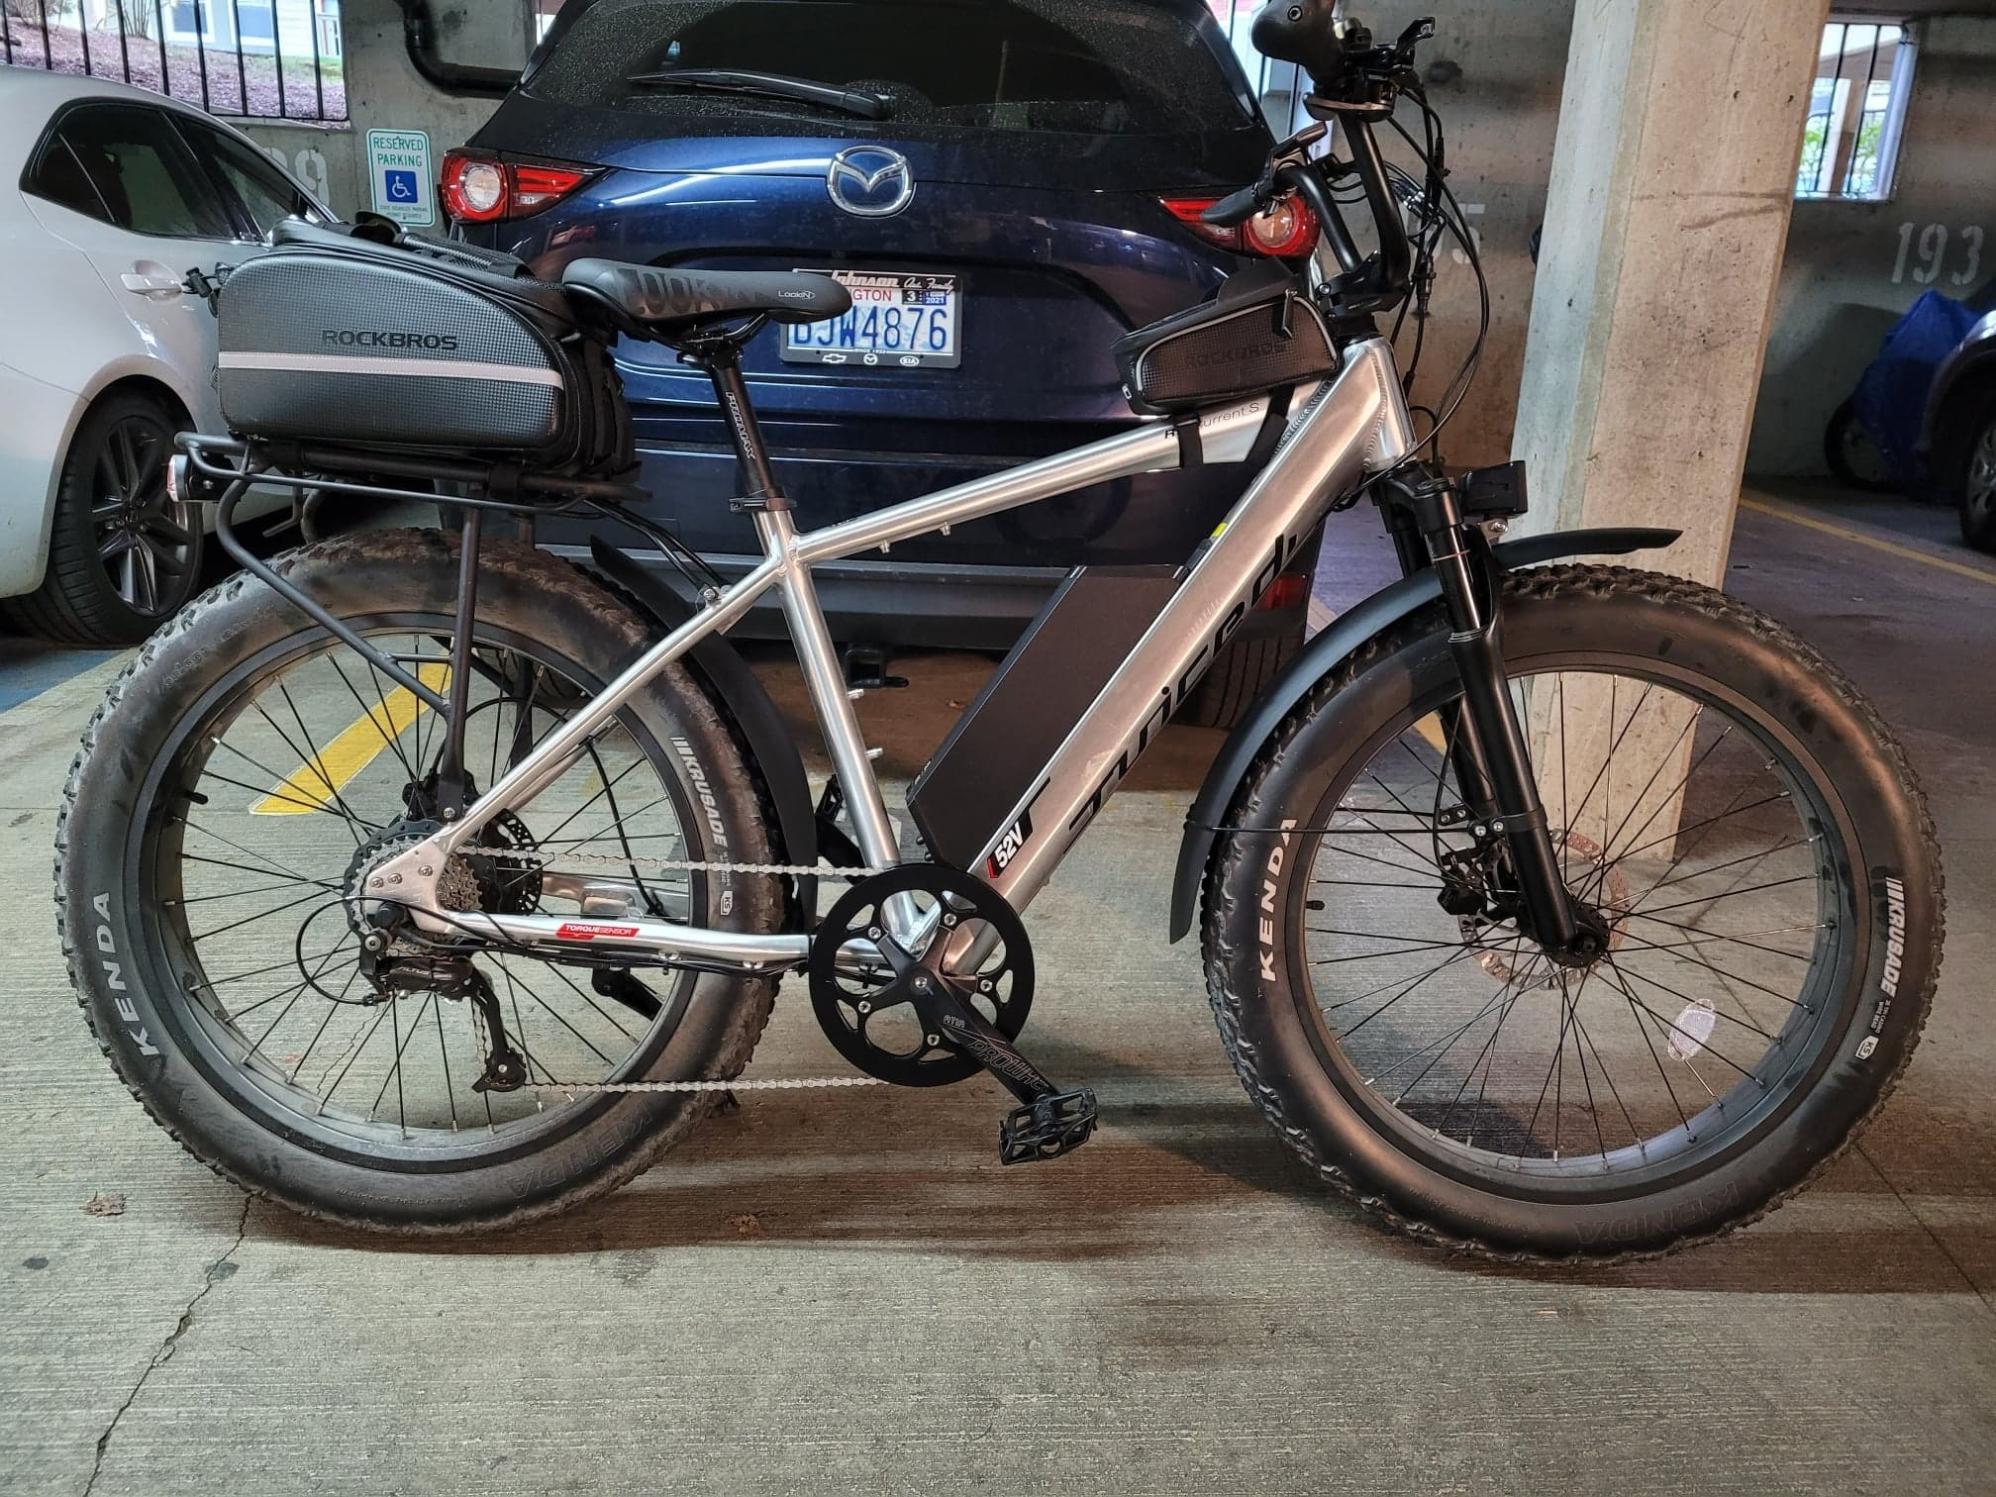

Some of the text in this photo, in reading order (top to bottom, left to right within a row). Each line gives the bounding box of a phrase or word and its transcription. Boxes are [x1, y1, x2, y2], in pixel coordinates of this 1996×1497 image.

[373, 136, 423, 151] RESERVED
[377, 153, 423, 167] PARKING
[1892, 221, 1985, 285] 193
[849, 288, 892, 302] GTON
[322, 330, 458, 351] ROCKBROS
[1248, 402, 1260, 414] S
[682, 754, 728, 847] KRUSADE
[993, 821, 1024, 868] 52V
[1259, 819, 1298, 981] KENDA
[1880, 898, 1905, 998] KRUSADE
[93, 892, 160, 1056] KENDA
